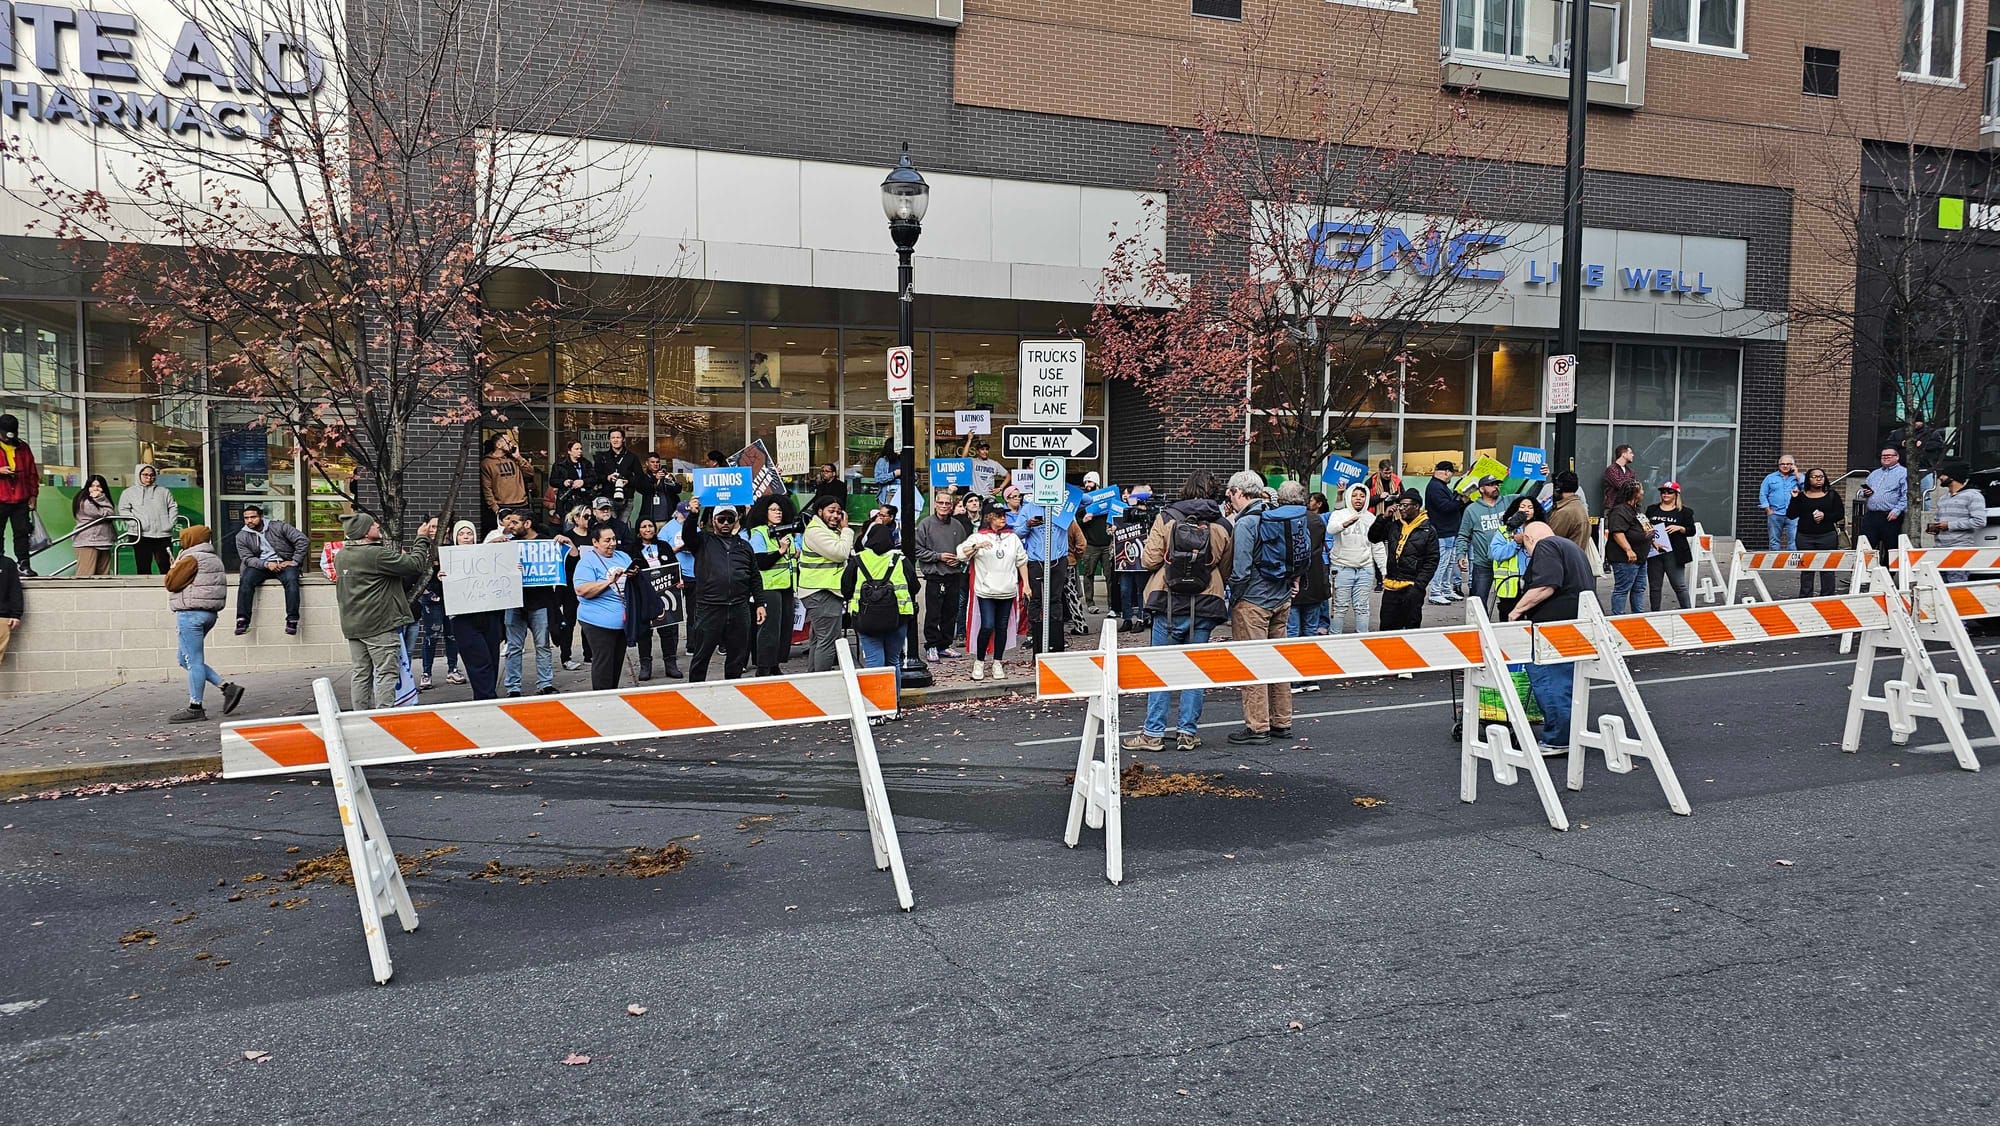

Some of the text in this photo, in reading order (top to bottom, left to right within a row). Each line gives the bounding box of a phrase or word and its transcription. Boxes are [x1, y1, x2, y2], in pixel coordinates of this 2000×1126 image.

[0, 0, 325, 99] ITE AID
[1, 79, 283, 139] HARMACY
[1308, 221, 1507, 281] GNC
[1530, 260, 1713, 294] LIE WELL
[1027, 350, 1077, 363] TRUCKS
[1039, 368, 1064, 380] USE
[1032, 385, 1069, 397] RIGHT
[1033, 402, 1068, 415] LANE
[961, 414, 985, 423] LATINOS
[583, 432, 609, 441] ALLENT
[780, 428, 801, 438] MAKE
[590, 441, 610, 449] POLIC
[778, 439, 807, 450] RACISM
[1012, 436, 1069, 448] ONE WAY
[1518, 450, 1542, 465] LATINOS
[937, 461, 966, 473] LATINOS
[1333, 460, 1362, 478] LATINOS
[703, 472, 743, 487] LATINOS
[1017, 473, 1034, 482] LATIN
[519, 541, 563, 563] ARRIS
[448, 549, 511, 576] FUCK
[654, 581, 672, 592] VOTE
